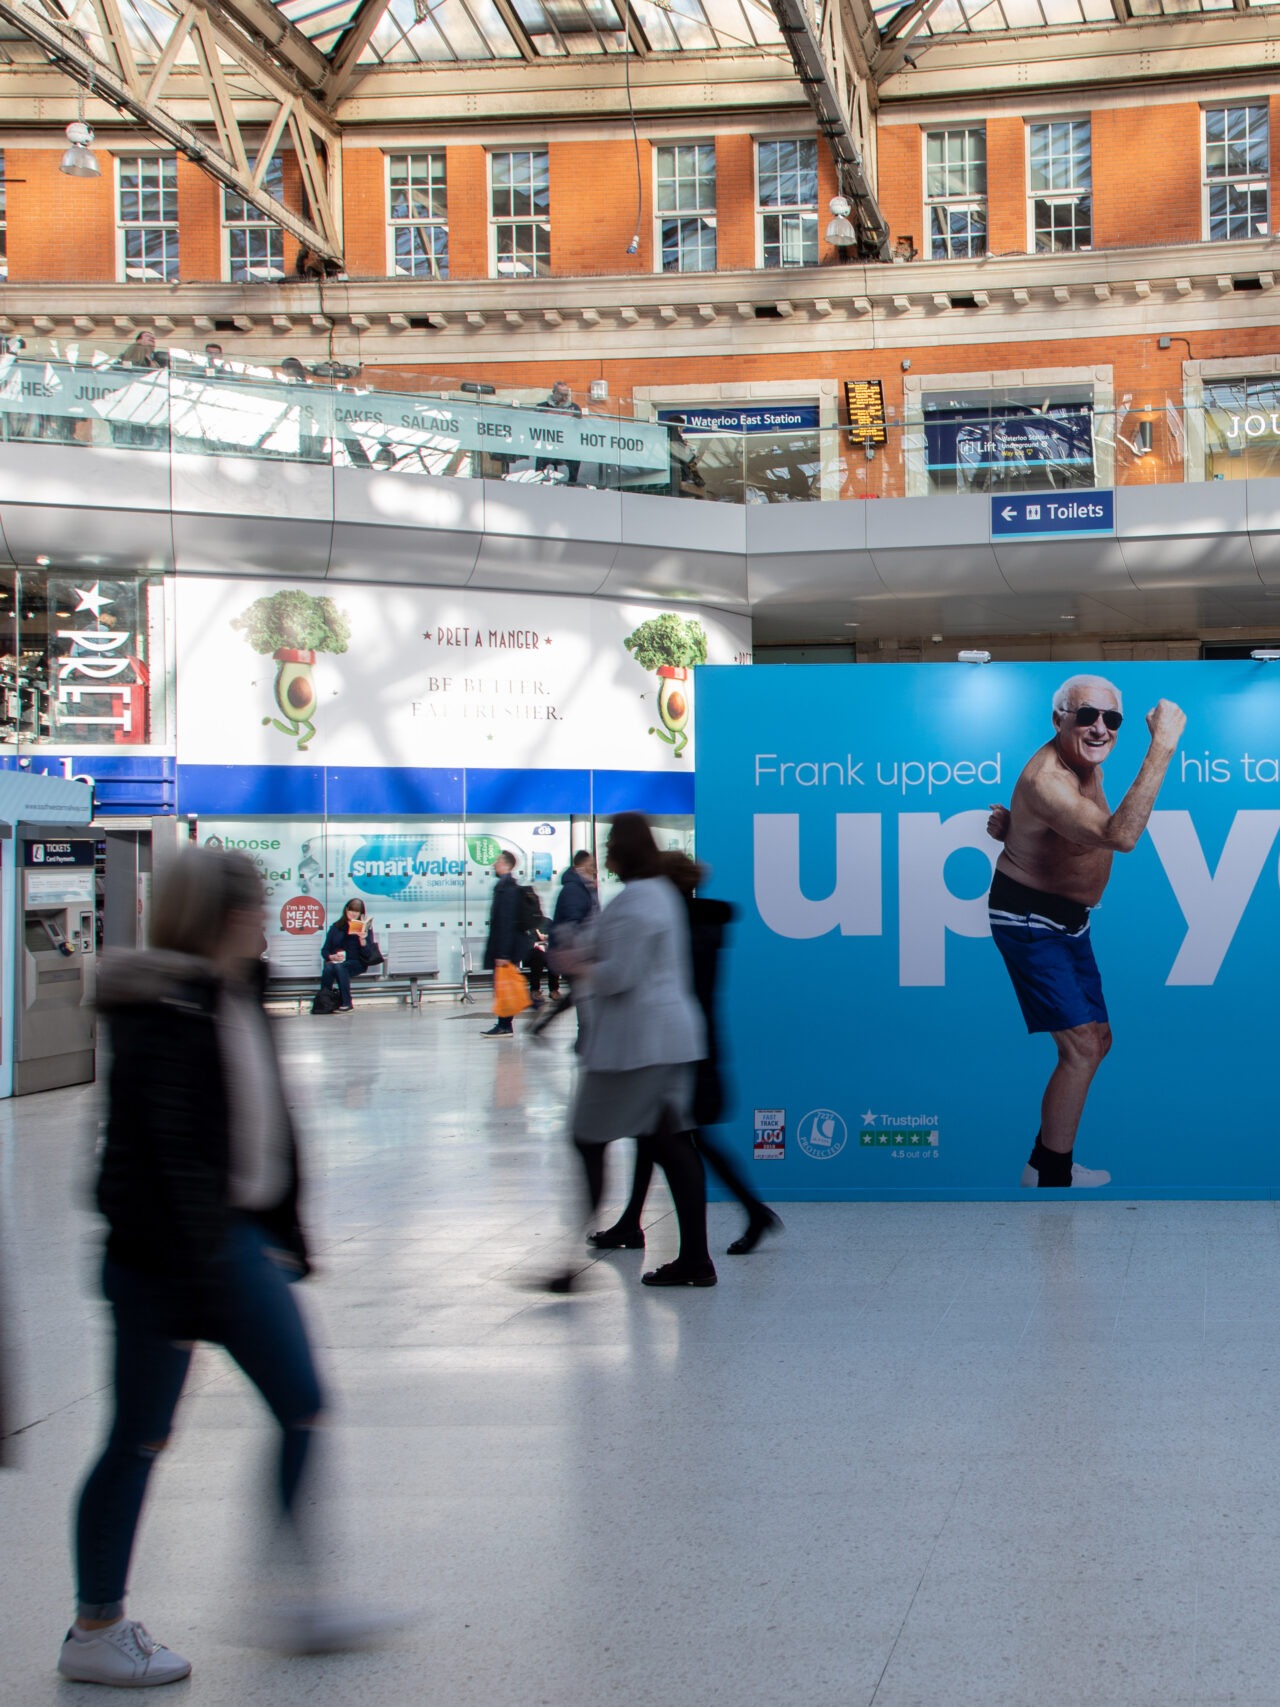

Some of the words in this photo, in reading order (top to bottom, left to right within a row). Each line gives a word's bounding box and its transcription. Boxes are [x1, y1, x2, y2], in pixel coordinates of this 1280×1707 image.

[691, 416, 738, 427] Waterloo
[740, 415, 761, 425] East
[764, 413, 802, 424] Station
[333, 407, 383, 424] CAKES
[401, 414, 459, 433] SALADS
[477, 421, 512, 438] BEER
[529, 427, 564, 444] WINE
[580, 433, 606, 448] HOT
[610, 436, 644, 452] FOOD
[977, 442, 996, 453] Lift
[1046, 503, 1104, 519] Toilets
[437, 627, 470, 647] PRET
[475, 630, 483, 648] A
[488, 629, 540, 650] MANGER
[57, 630, 133, 732] PRET
[754, 754, 865, 786] Frank
[877, 753, 1001, 795] upped
[1181, 750, 1230, 783] his
[46, 843, 71, 853] TICKETS
[352, 857, 467, 876] smartwater
[753, 809, 1003, 987] up
[286, 911, 319, 920] MEAL
[286, 919, 319, 929] DEAL
[880, 1114, 939, 1128] Trustpilot
[756, 1129, 783, 1143] 100
[801, 1136, 840, 1157] PROTECTED
[891, 1150, 905, 1158] 4.5
[922, 1150, 931, 1158] of
[933, 1150, 939, 1158] 5
